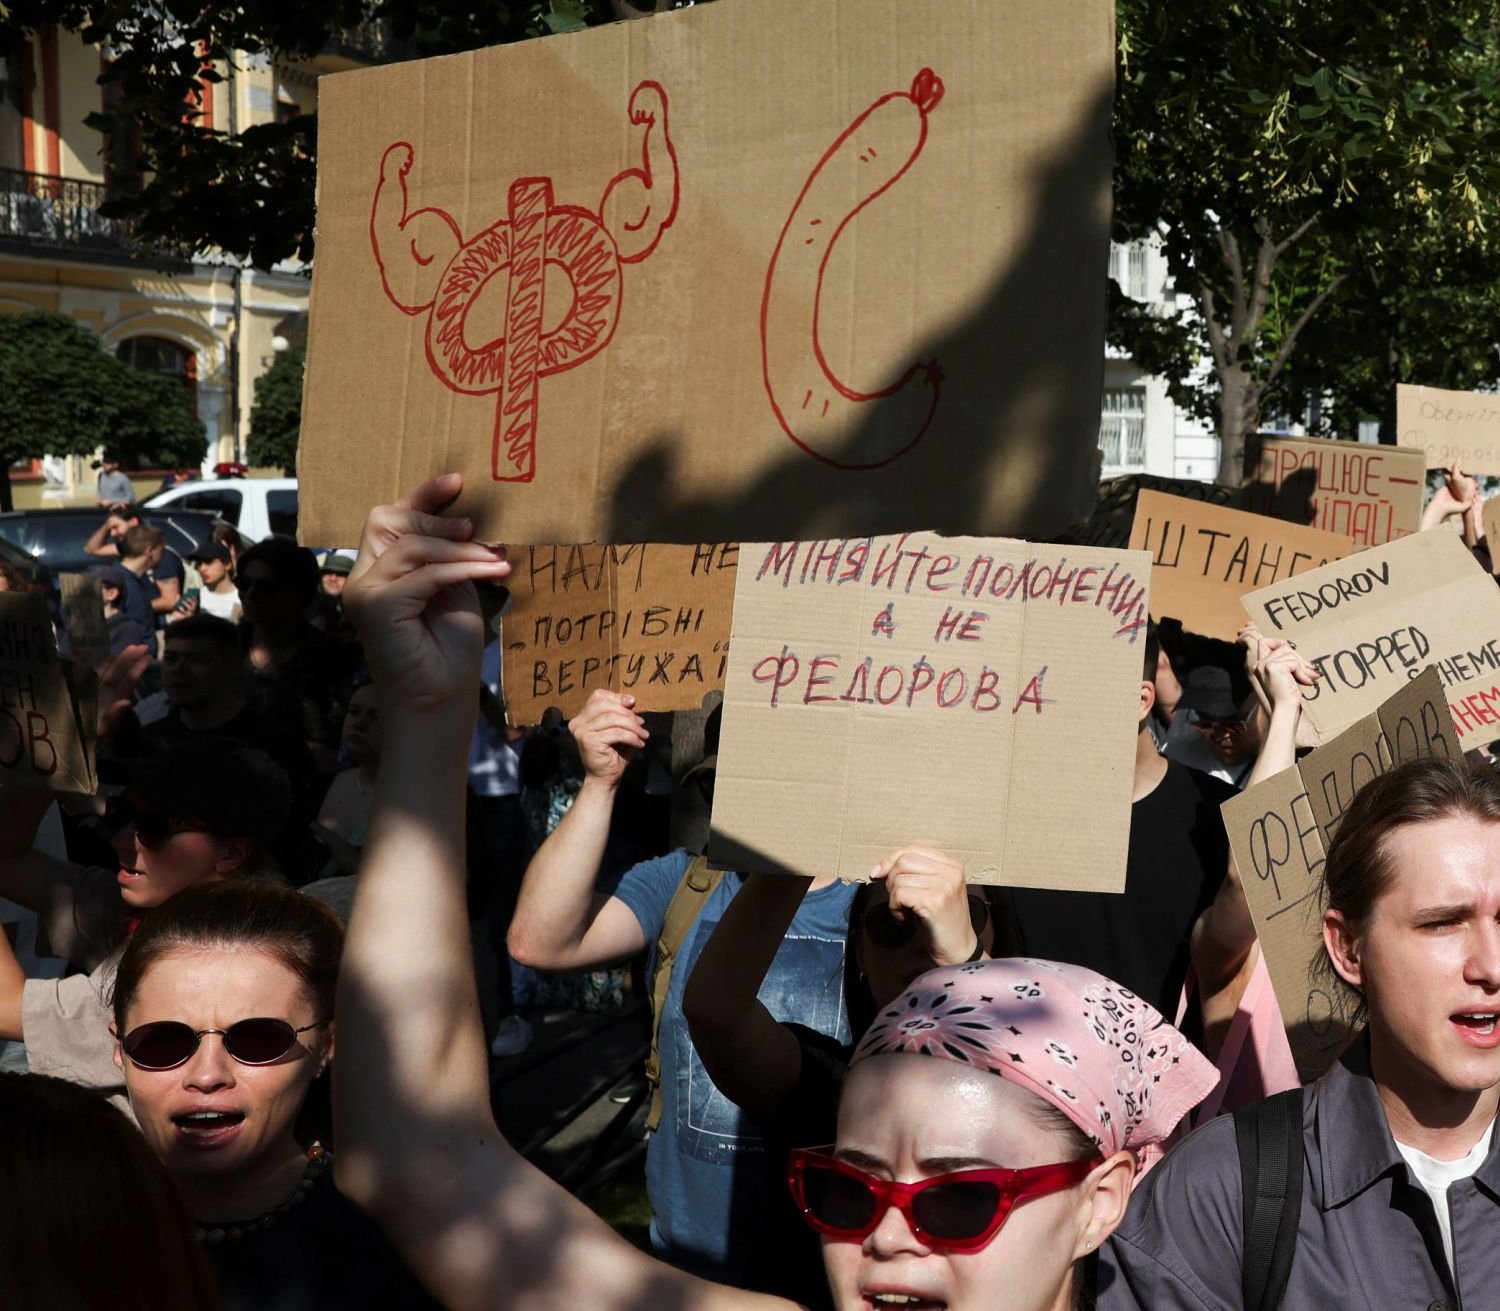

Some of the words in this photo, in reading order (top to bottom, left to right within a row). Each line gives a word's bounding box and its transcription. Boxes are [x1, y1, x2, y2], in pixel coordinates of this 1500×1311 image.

[934, 605, 990, 644] НЕ
[1263, 561, 1390, 630] FEDOROV
[751, 645, 1059, 715] ФЕДОРОВА
